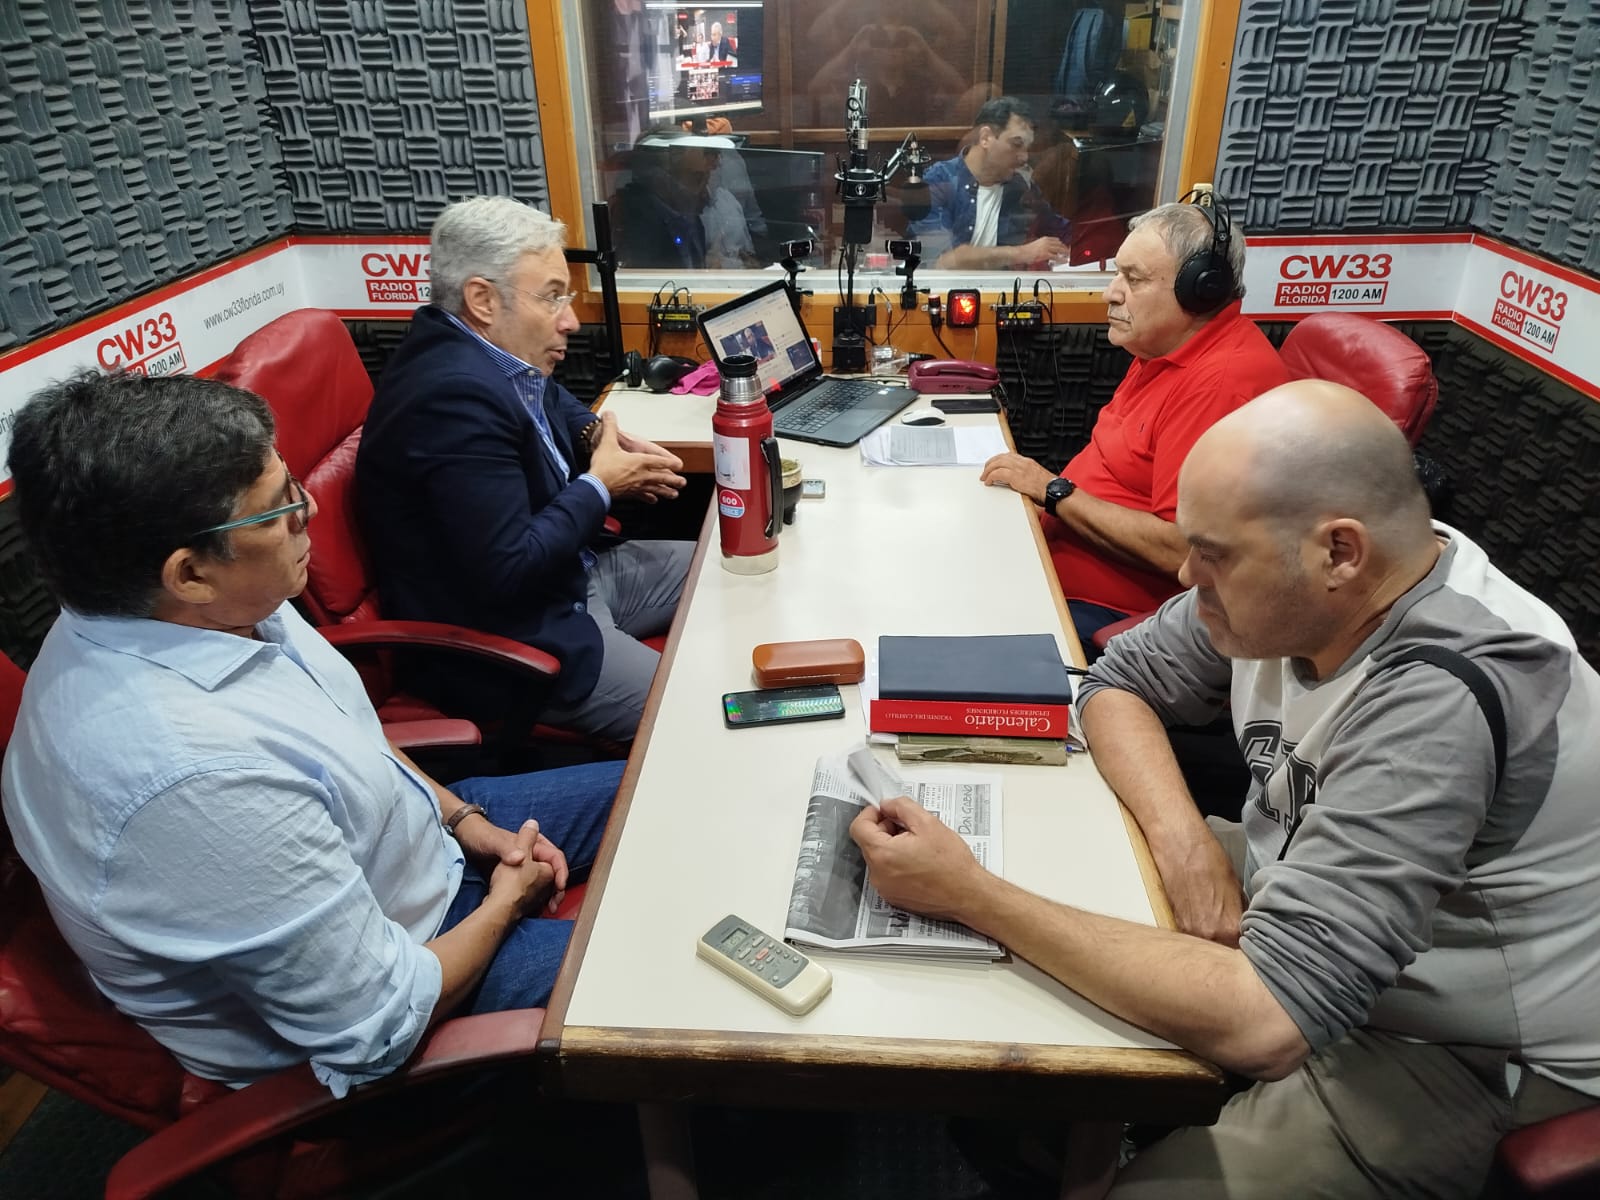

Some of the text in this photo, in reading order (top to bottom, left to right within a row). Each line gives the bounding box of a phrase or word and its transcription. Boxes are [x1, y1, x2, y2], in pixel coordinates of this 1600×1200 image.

[1280, 254, 1392, 280] CW33
[370, 282, 412, 291] RADIO
[373, 292, 416, 301] FLORIDA
[418, 286, 431, 297] 12
[1281, 285, 1327, 295] RADIO
[1332, 288, 1382, 300] 1200 AM
[1500, 271, 1568, 321] CW33
[203, 281, 285, 330] www.cw33florida.com.uy
[1279, 295, 1326, 304] FLORIDA
[1497, 302, 1523, 322] RADIO
[1494, 313, 1520, 334] FLORIDA
[1523, 320, 1555, 345] 1200 AM
[97, 312, 177, 371] CW33
[148, 359, 167, 377] 1200
[168, 351, 182, 368] AM
[965, 714, 1051, 732] Calendario
